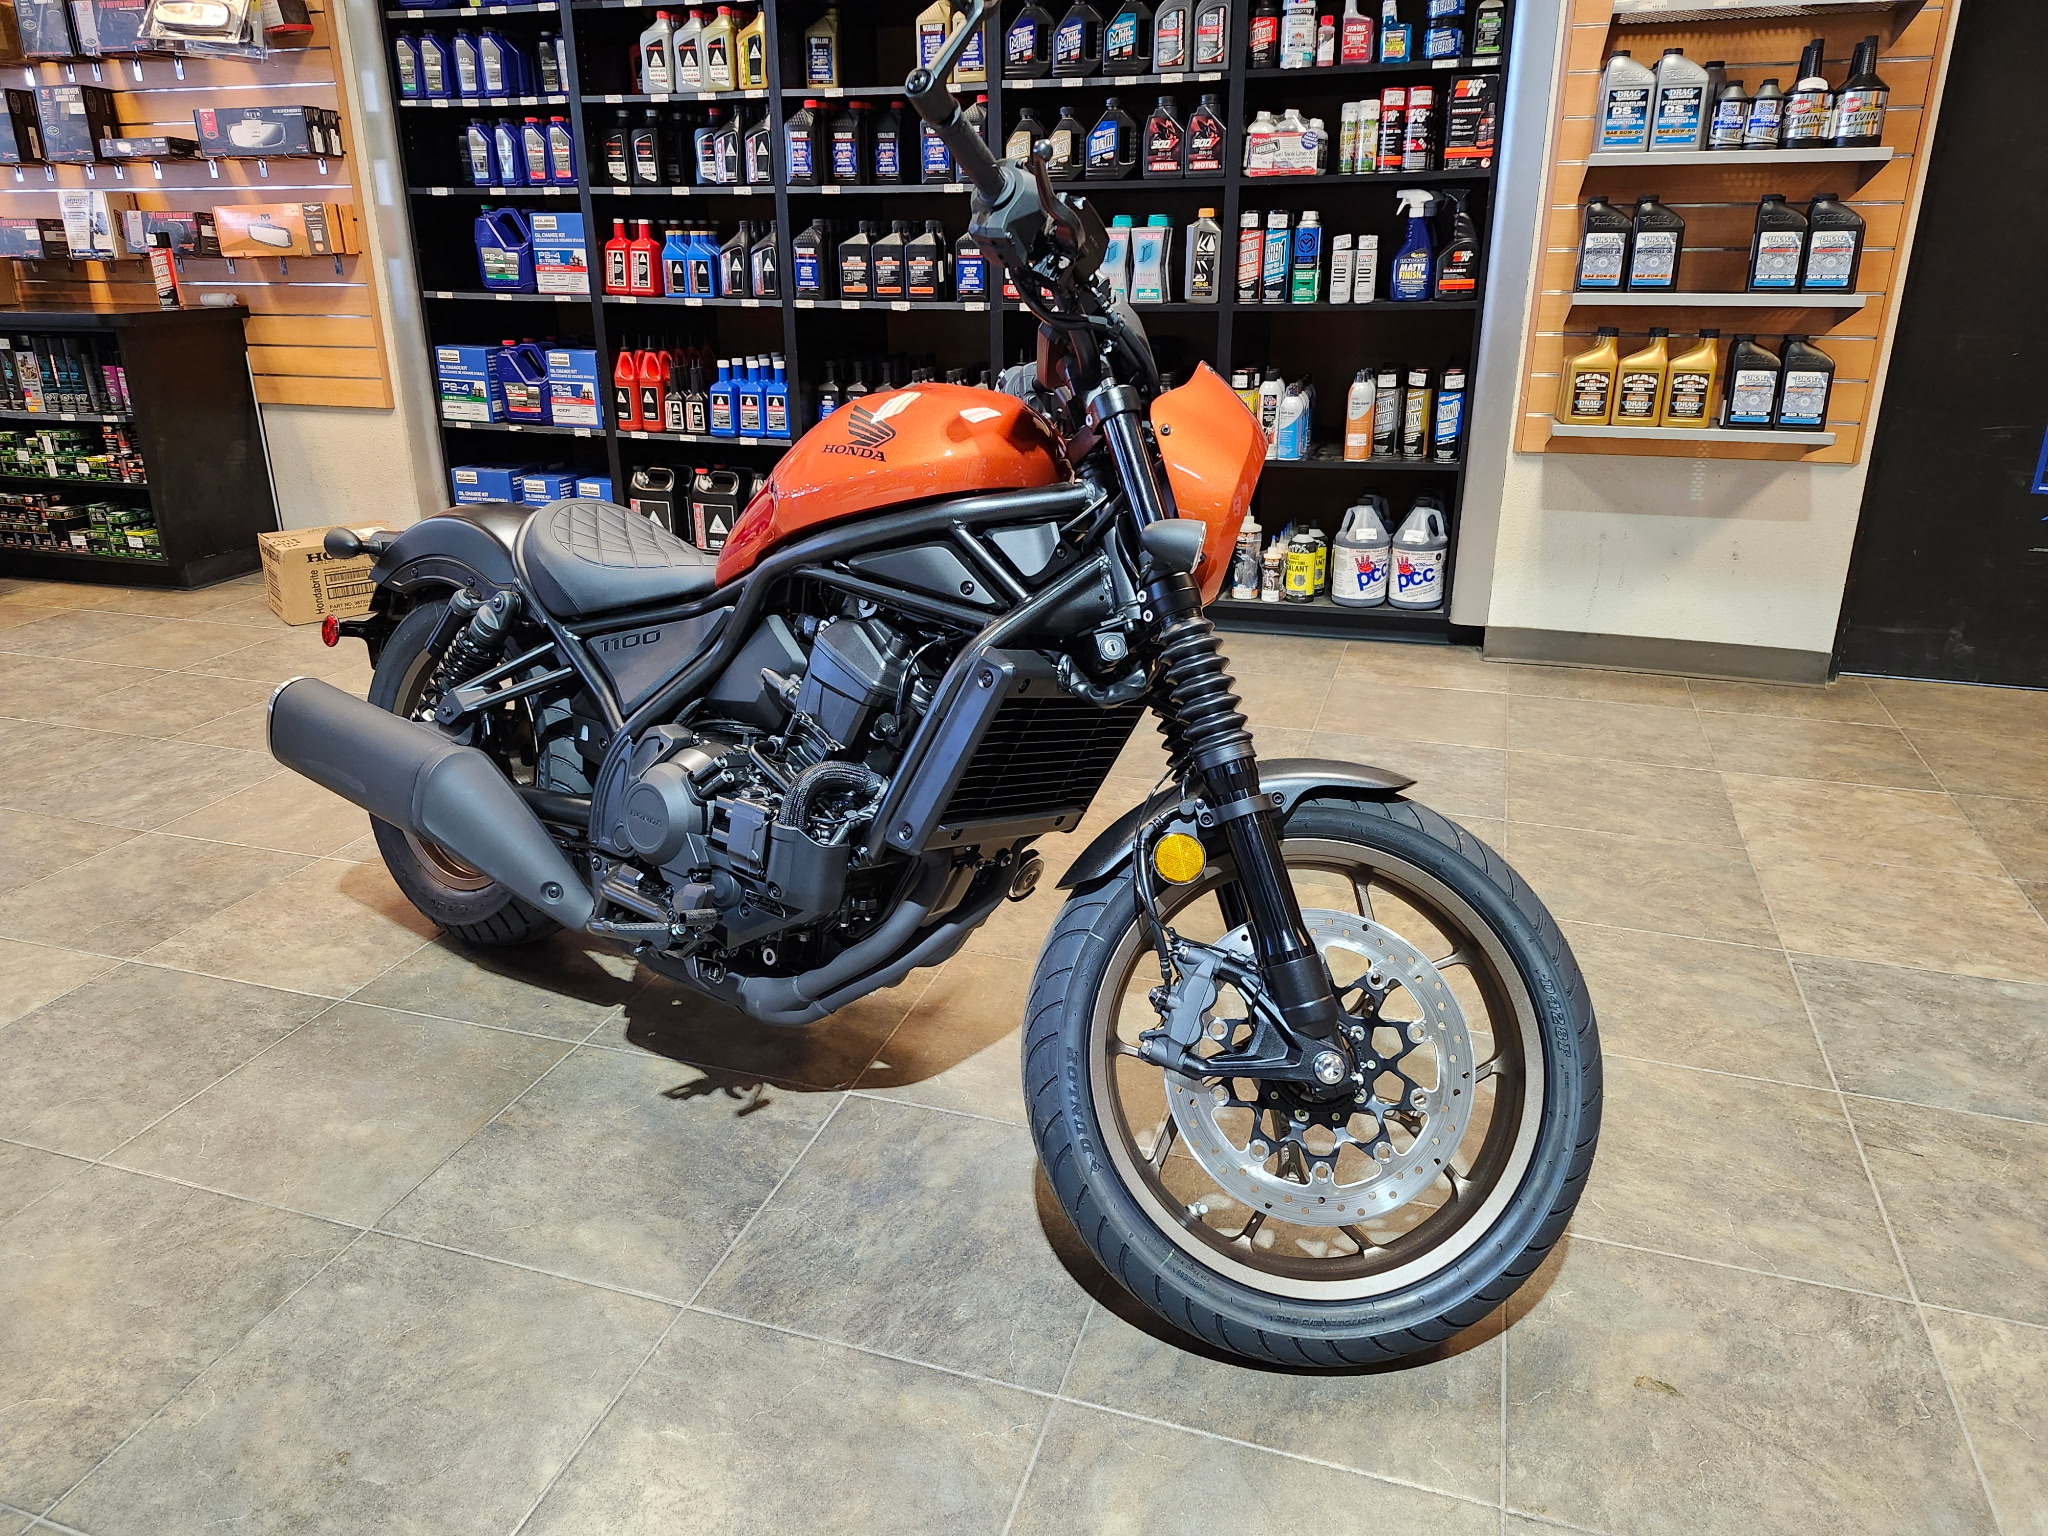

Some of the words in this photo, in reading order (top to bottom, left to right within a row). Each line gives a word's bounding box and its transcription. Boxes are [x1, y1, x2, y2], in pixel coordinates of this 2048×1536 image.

[1617, 90, 1642, 98] DRAG
[1670, 88, 1694, 97] DRAG
[1609, 100, 1646, 108] PREMIUM
[1150, 138, 1179, 150] 300V
[1191, 137, 1221, 148] 300V
[1254, 141, 1278, 153] KREEM
[1152, 162, 1178, 170] MOTUL
[1193, 161, 1218, 170] MOTUL
[65, 196, 88, 205] MOOSE
[1399, 263, 1427, 272] MATTE
[1398, 271, 1422, 280] FINISH
[1575, 373, 1609, 385] GEAR
[1623, 373, 1658, 386] GEAR
[1673, 374, 1708, 386] GEAR
[442, 382, 470, 392] PS-4
[822, 443, 887, 463] HONDA
[1397, 567, 1436, 593] pcc
[310, 569, 325, 615] Hondabrite
[600, 630, 661, 653] 1100
[629, 809, 662, 828] HONDA
[1540, 979, 1572, 1058] D428F
[1066, 1046, 1095, 1155] DUNLOP
[1176, 1270, 1206, 1293] TUBELESS
